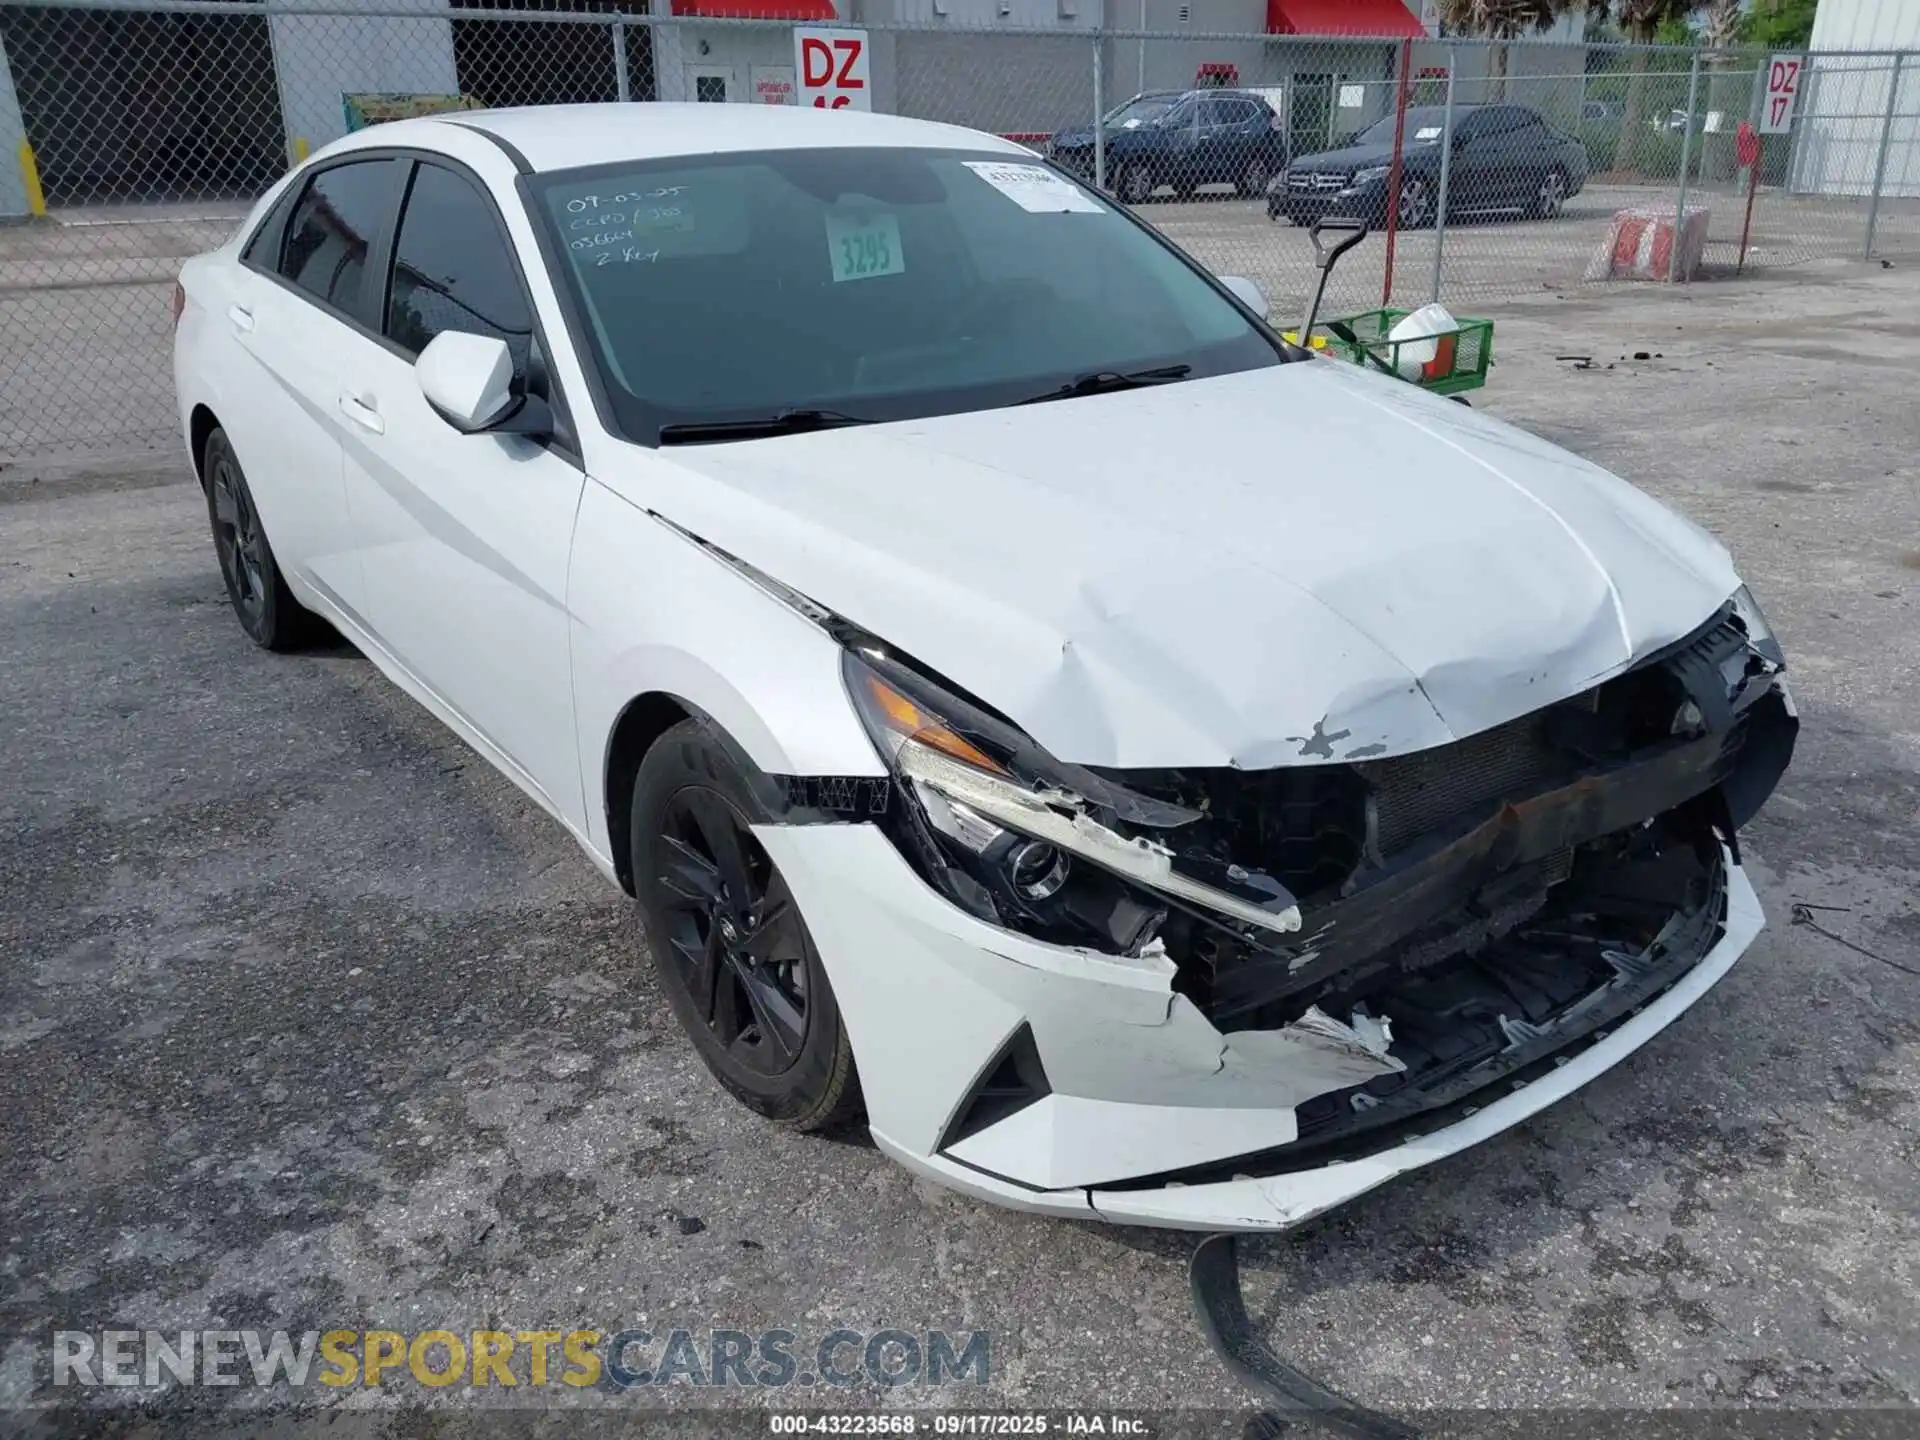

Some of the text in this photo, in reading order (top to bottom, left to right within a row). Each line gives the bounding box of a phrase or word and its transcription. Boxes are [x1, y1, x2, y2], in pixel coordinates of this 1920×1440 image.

[801, 38, 864, 88] DZ
[1770, 61, 1799, 92] DZ
[1770, 97, 1788, 127] 17
[841, 231, 890, 276] 3295
